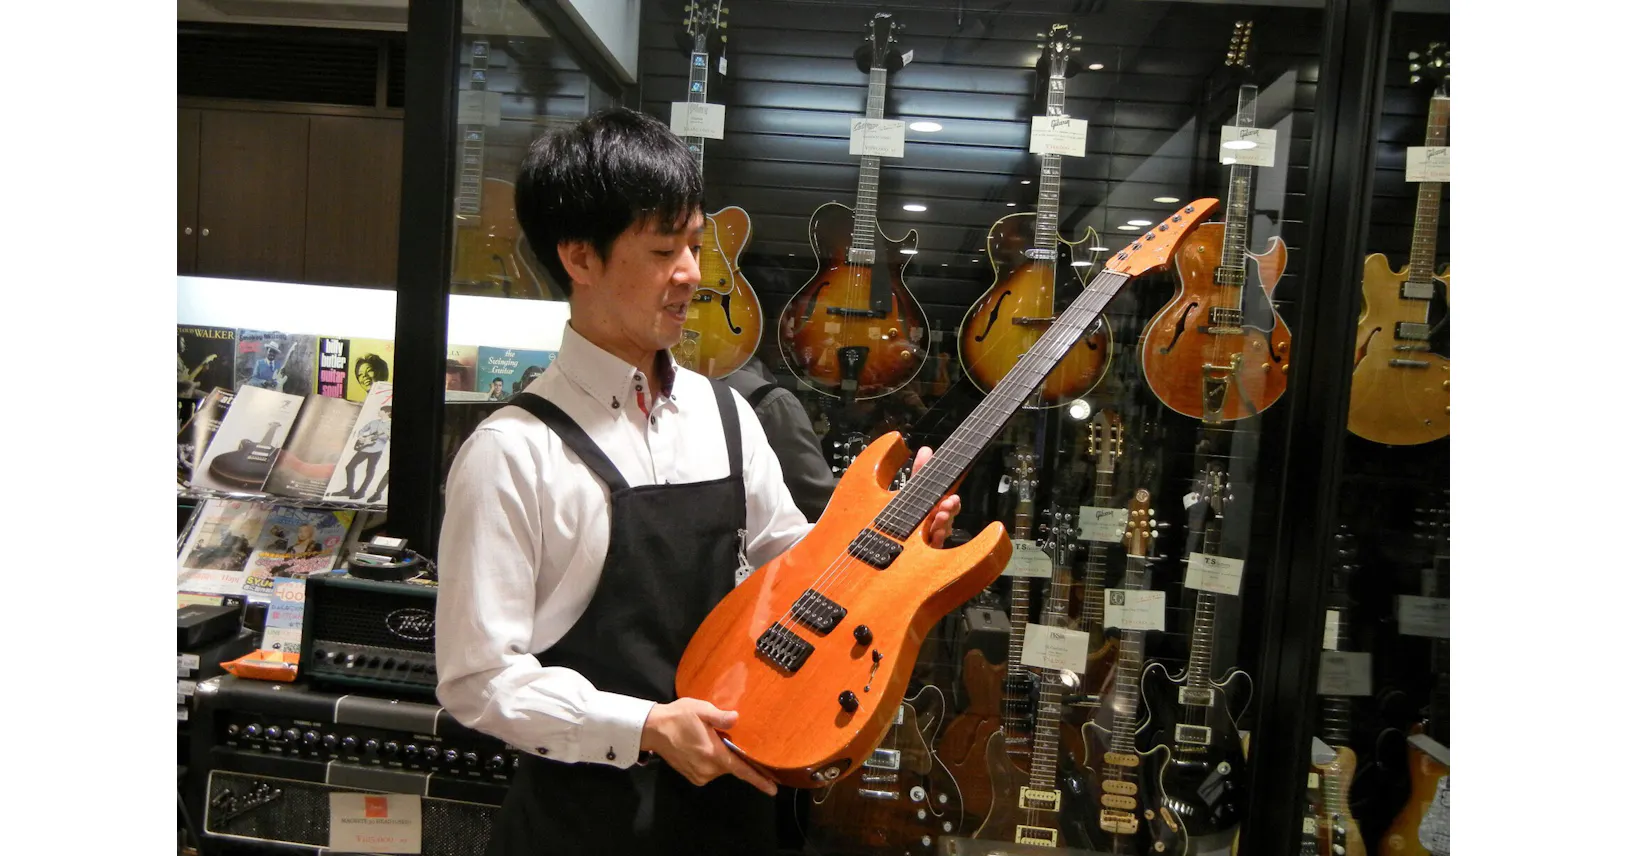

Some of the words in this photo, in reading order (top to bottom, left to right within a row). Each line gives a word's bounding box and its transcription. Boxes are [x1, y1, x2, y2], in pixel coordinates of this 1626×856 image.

[1051, 119, 1070, 130] Gibson
[1240, 129, 1259, 140] Gibson
[194, 328, 235, 340] WALKER
[325, 338, 344, 356] billy
[504, 349, 516, 358] the
[321, 353, 347, 369] butler
[487, 356, 519, 368] Swinging
[491, 366, 515, 375] Guitar
[321, 369, 346, 384] guitar
[1095, 510, 1114, 521] Gibson
